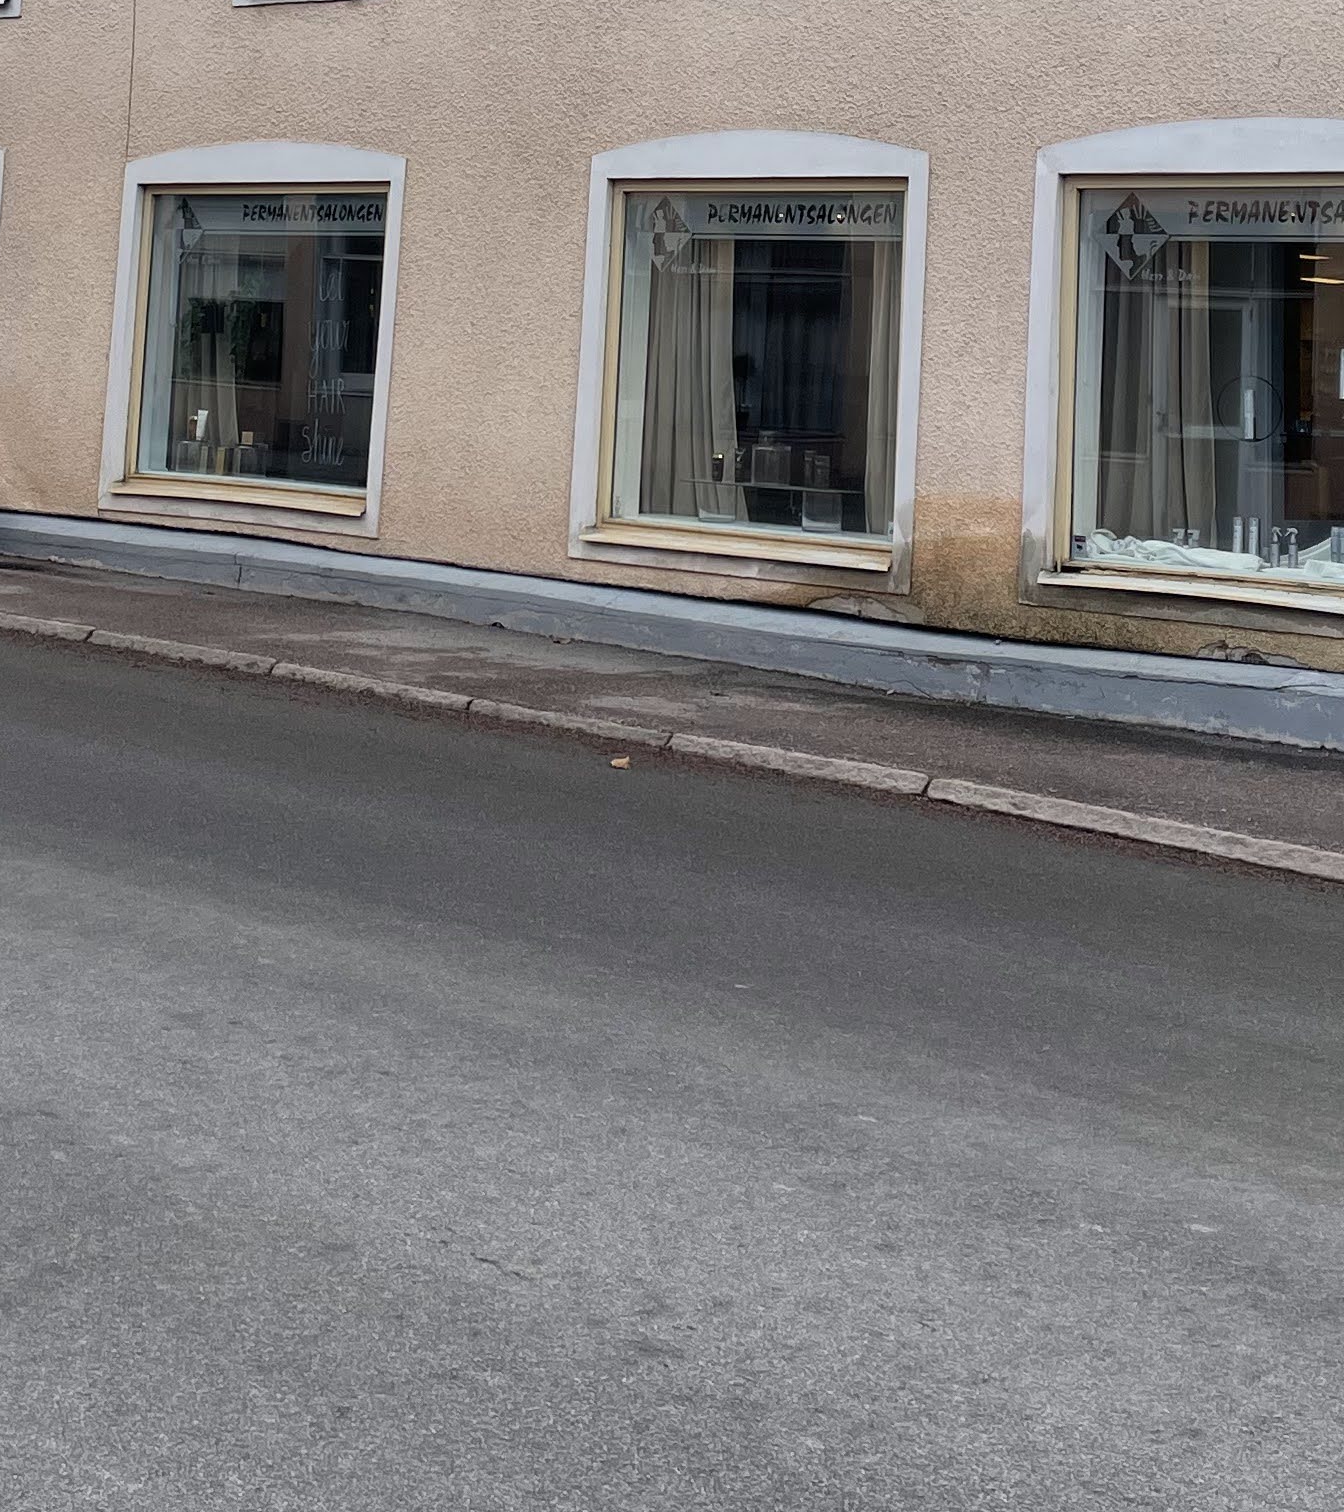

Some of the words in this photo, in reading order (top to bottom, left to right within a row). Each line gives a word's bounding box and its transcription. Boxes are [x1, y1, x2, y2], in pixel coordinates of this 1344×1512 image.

[242, 203, 384, 223] PERMANENTSALONGEN
[707, 201, 897, 225] PERMANENTSALONGEN
[308, 319, 350, 379] your
[307, 378, 346, 414] HAIR
